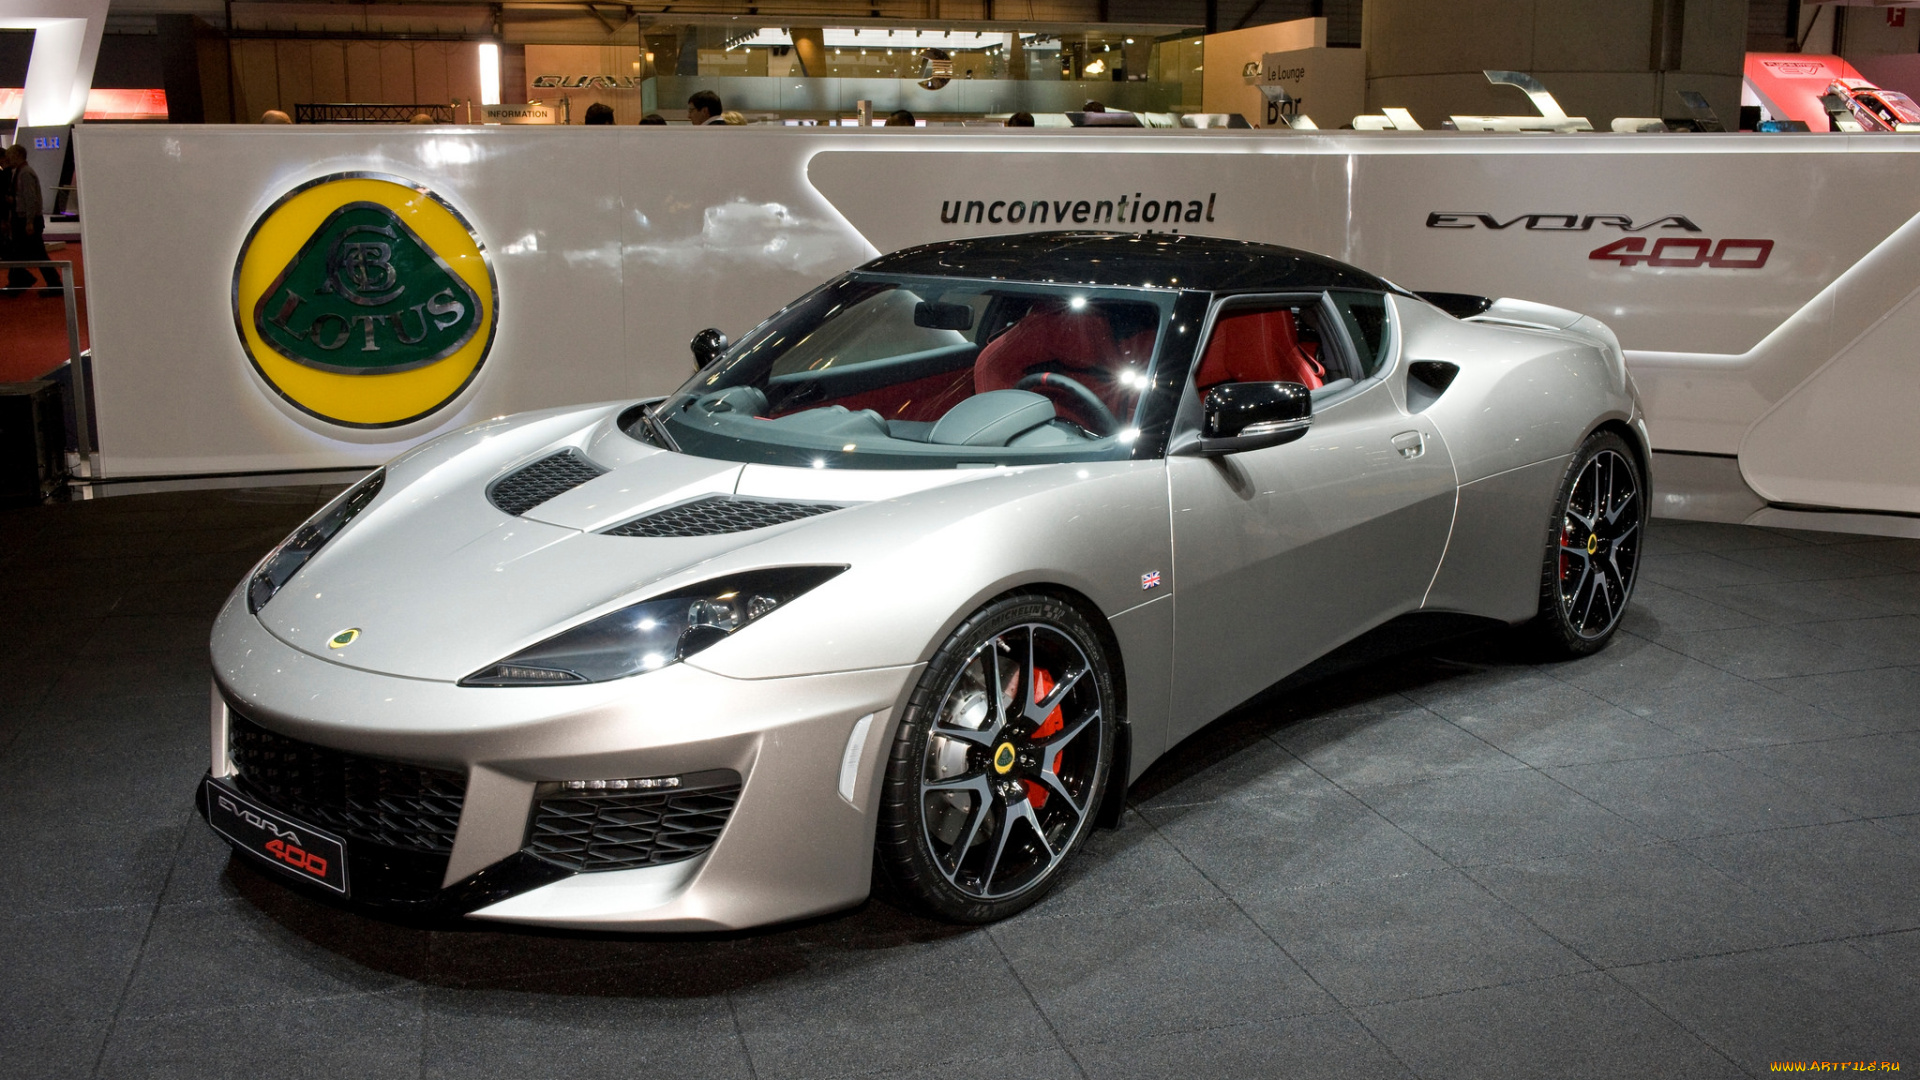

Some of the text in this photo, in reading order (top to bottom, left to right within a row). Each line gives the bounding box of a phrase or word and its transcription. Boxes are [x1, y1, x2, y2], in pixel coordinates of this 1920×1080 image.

[1267, 66, 1277, 81] Le
[1278, 65, 1305, 83] Lounge
[487, 110, 548, 118] INFORMATION
[940, 192, 1217, 224] unconventional
[1426, 211, 1703, 232] EVORA
[1588, 237, 1775, 269] 400
[268, 287, 466, 352] LOTUS
[990, 605, 1042, 627] MICHELIN
[218, 795, 302, 845] EVORA
[265, 839, 328, 877] 400
